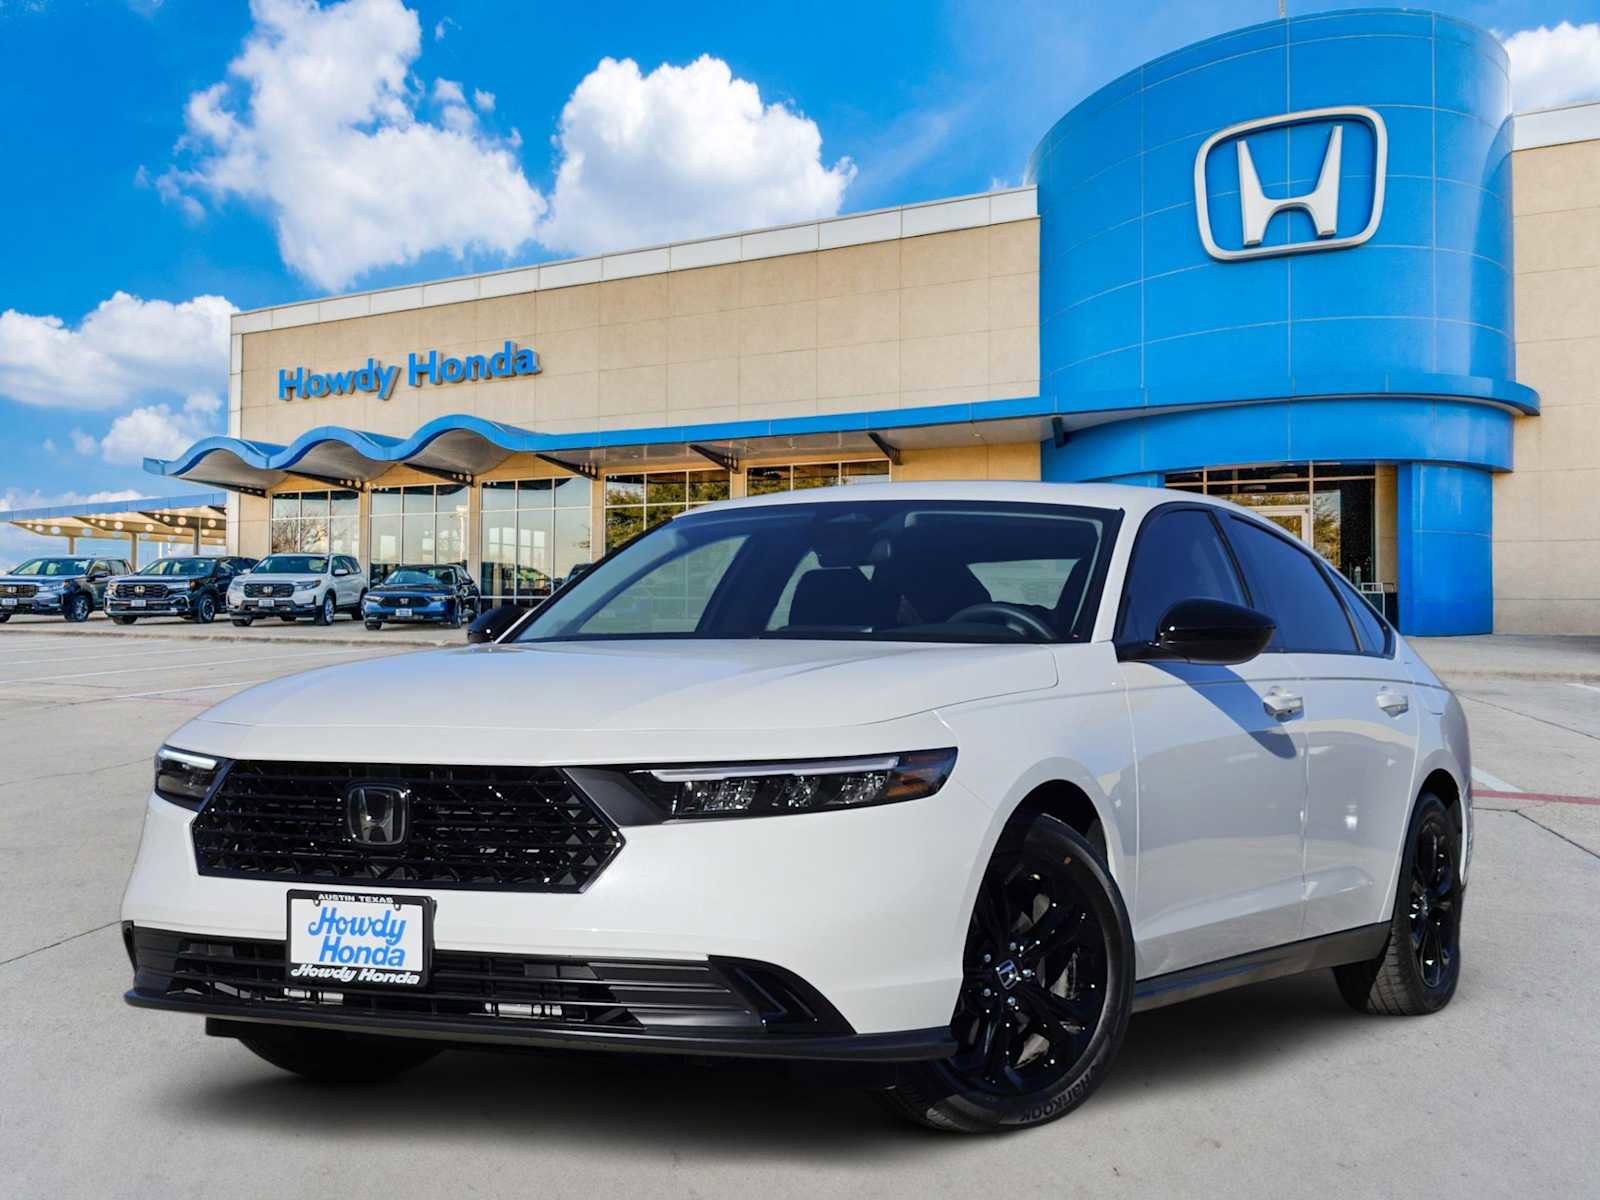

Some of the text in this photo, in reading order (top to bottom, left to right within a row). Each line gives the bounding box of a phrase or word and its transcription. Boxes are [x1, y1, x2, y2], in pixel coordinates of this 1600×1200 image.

[279, 340, 542, 400] Howdy Honda
[318, 894, 393, 904] AUSTIN TEXAS
[308, 906, 406, 945] Howdy
[319, 935, 405, 967] Honda
[291, 964, 420, 985] Howdy Honda
